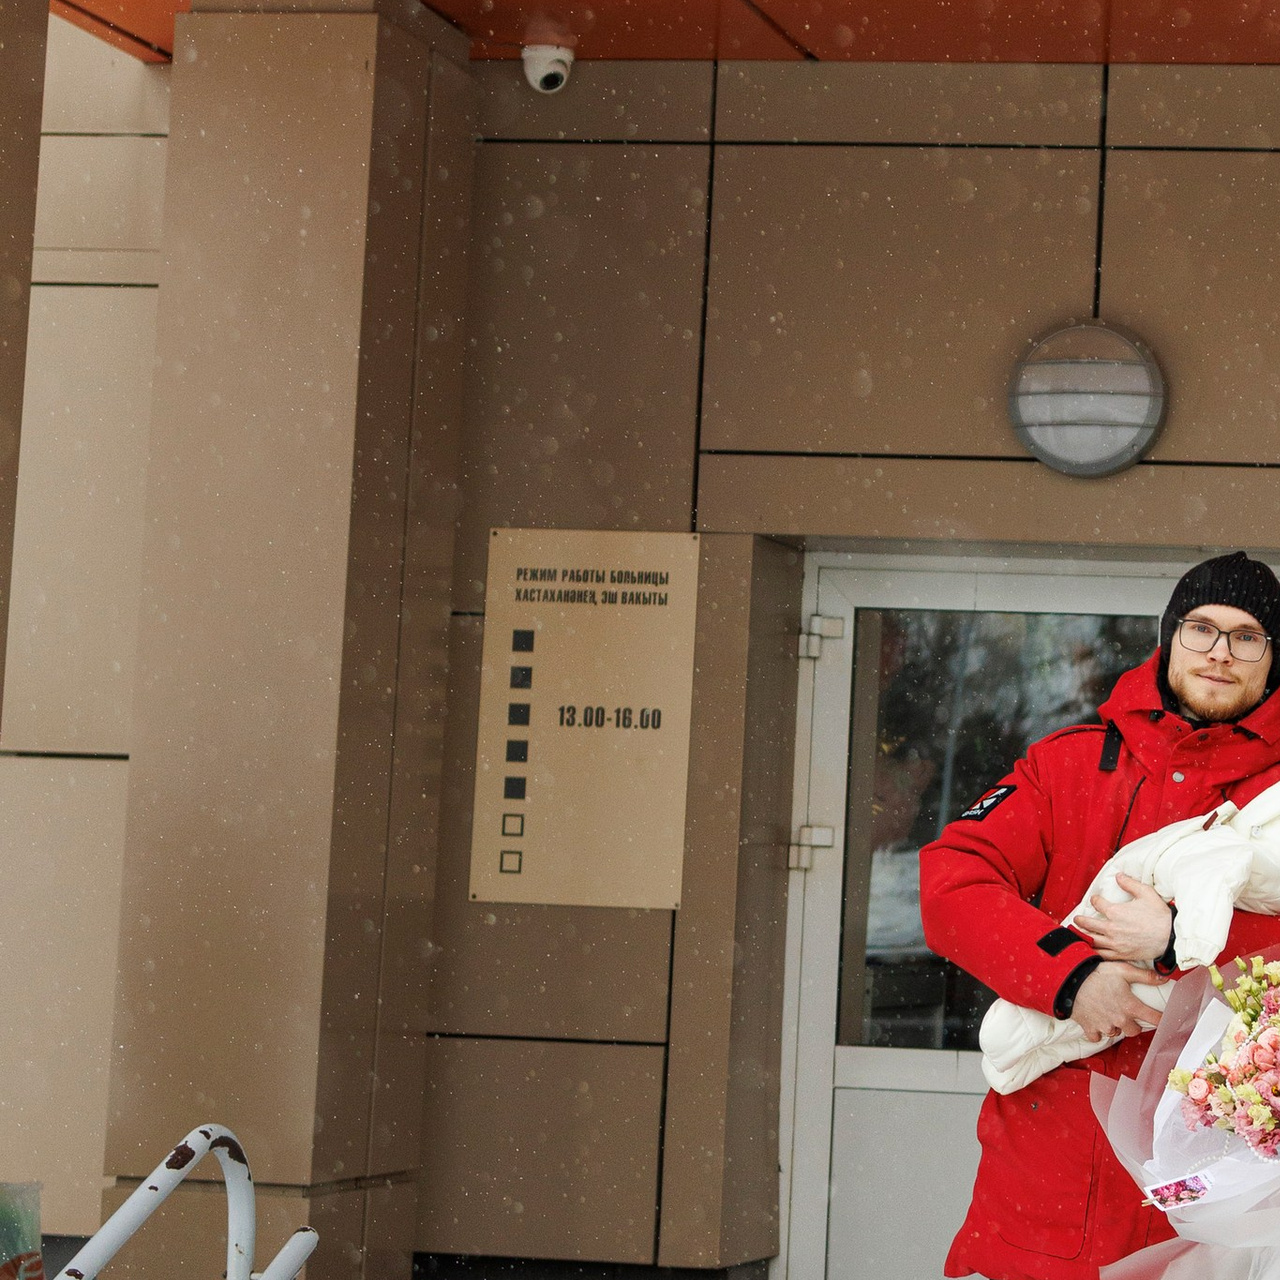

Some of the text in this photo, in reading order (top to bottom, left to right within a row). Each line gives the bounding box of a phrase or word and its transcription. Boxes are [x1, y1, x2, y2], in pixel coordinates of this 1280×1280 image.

[516, 567, 669, 587] РЕЖИМ РАБОТЫ БОЛЬНИЦЫ
[601, 591, 617, 604] ЭШ
[621, 591, 668, 606] ВАКЫТЫ
[558, 705, 662, 730] 13.00-16.00
